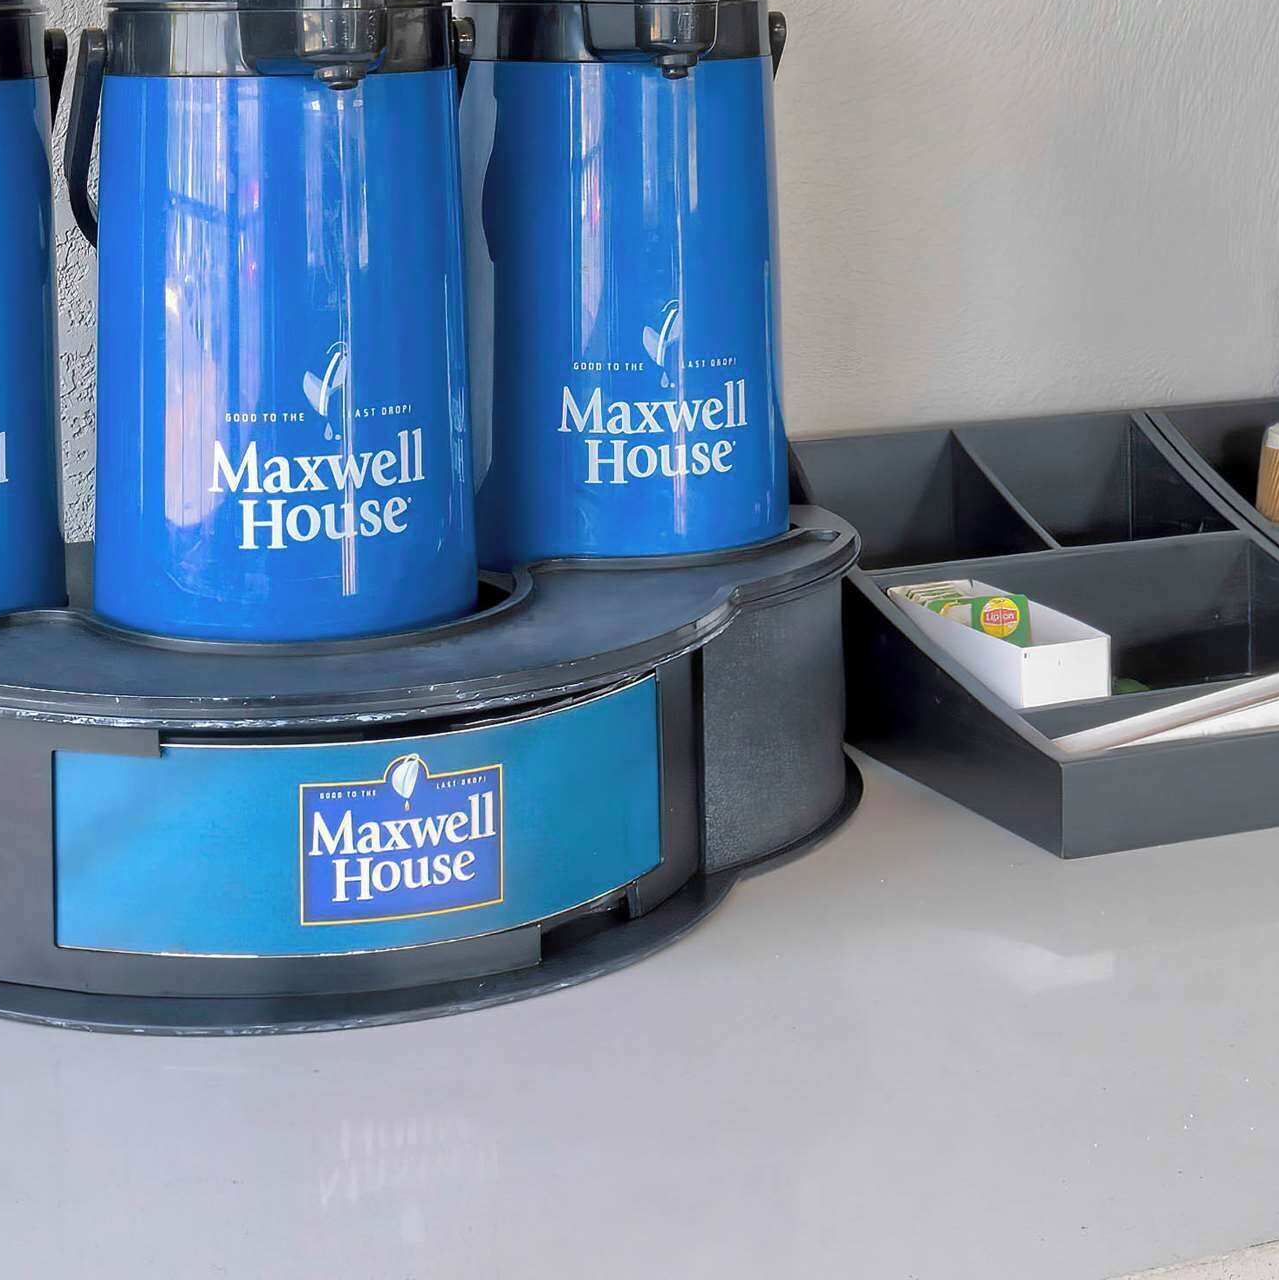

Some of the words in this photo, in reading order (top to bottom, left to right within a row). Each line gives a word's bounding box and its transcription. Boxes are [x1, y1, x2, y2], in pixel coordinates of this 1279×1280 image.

[573, 361, 601, 370] GOOD
[607, 362, 619, 370] TO
[625, 362, 644, 370] THE
[225, 412, 256, 422] GOOD
[263, 413, 276, 421] TO
[283, 412, 304, 421] THE
[381, 404, 411, 415] DROP!
[557, 379, 746, 432] Maxwell
[208, 428, 423, 492] Maxwell
[584, 439, 732, 482] House
[238, 496, 408, 548] House
[319, 791, 342, 799] GOOD
[347, 790, 356, 798] TO
[436, 779, 456, 789] LAST
[308, 790, 495, 854] Maxwell
[332, 850, 474, 900] House
